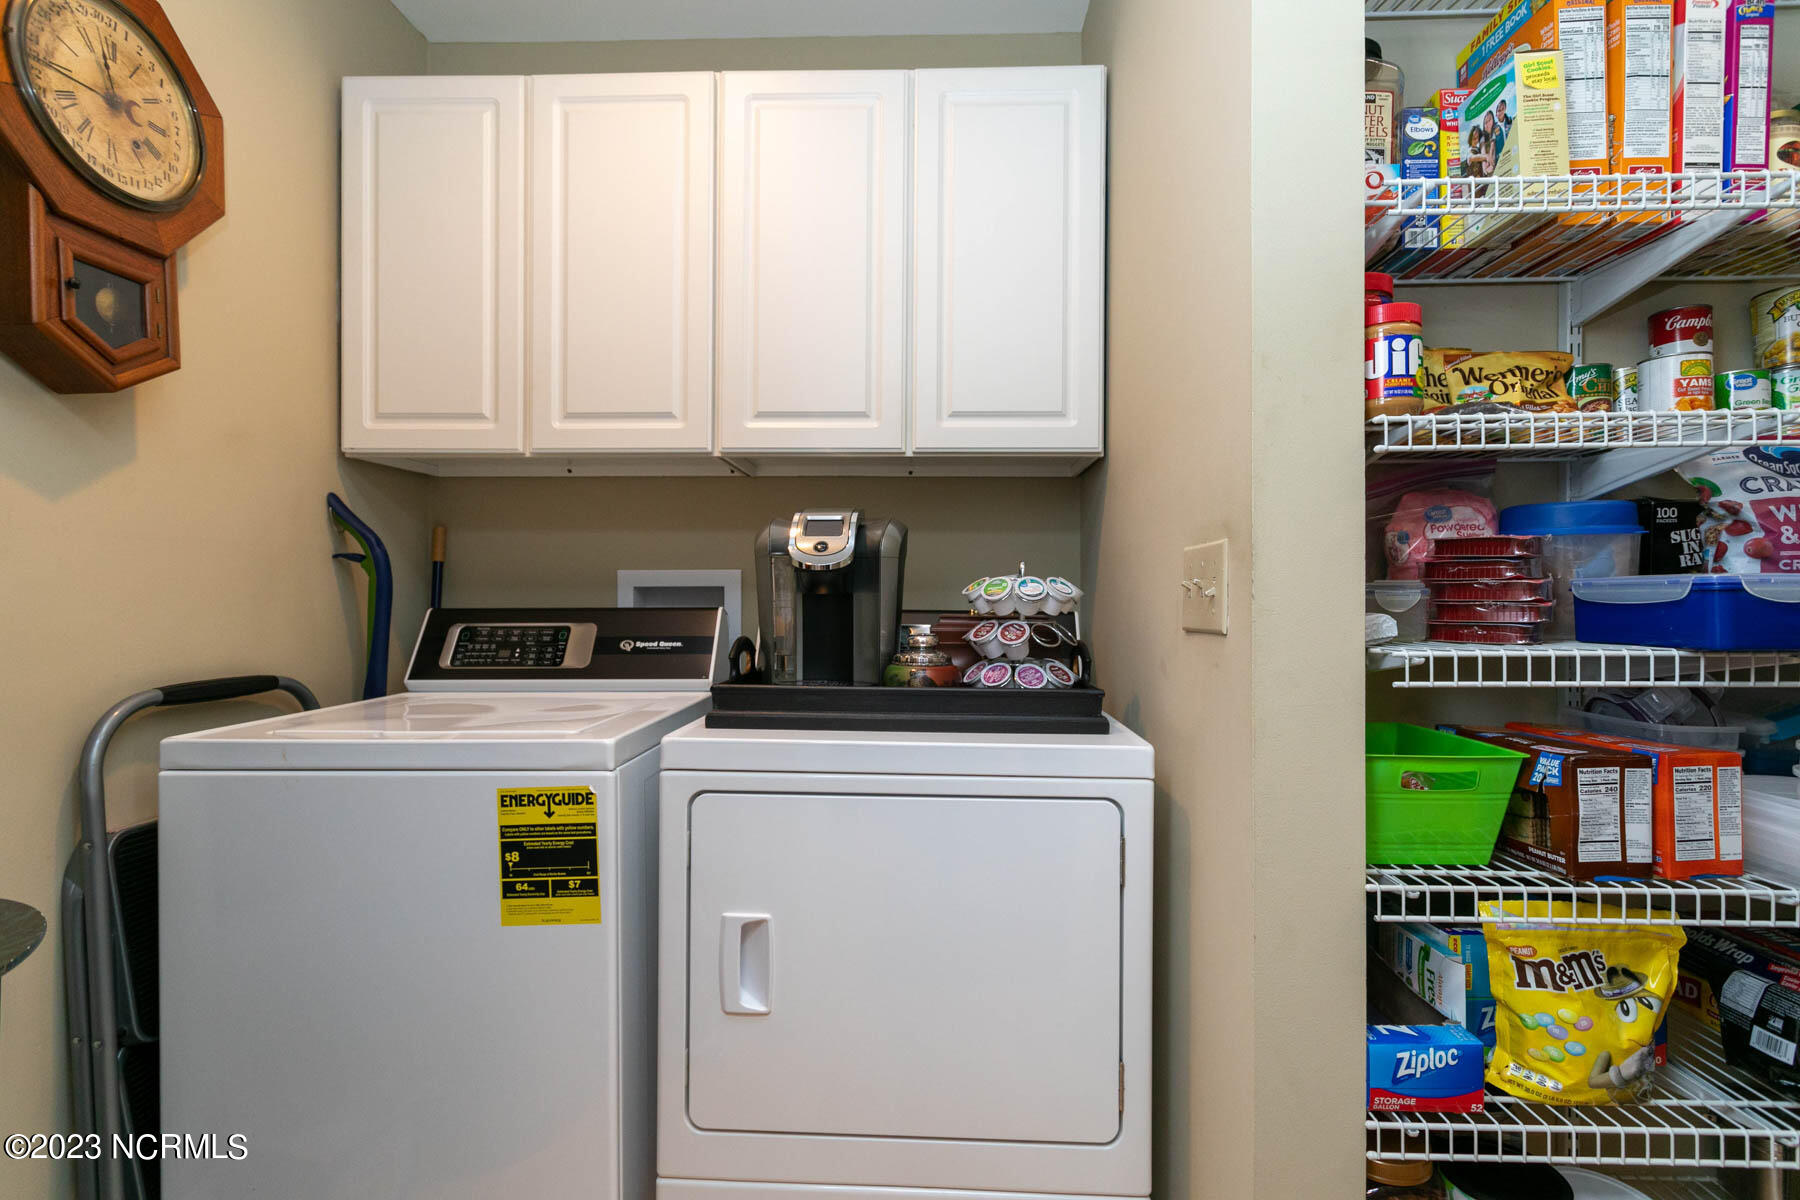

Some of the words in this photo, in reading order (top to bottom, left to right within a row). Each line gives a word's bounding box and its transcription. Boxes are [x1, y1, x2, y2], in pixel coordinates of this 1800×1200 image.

[90, 7, 104, 22] 30
[104, 15, 117, 32] 31
[1485, 27, 1505, 53] FREE
[1504, 3, 1529, 34] BOOK
[1470, 11, 1504, 53] FAMILY
[1525, 71, 1550, 80] proceeds
[1365, 338, 1423, 380] Jif
[1452, 365, 1564, 386] Werer's
[1567, 368, 1598, 386] Amy's
[1680, 379, 1712, 387] YAMS
[1488, 379, 1560, 400] Orinal
[1749, 453, 1784, 472] Ocean
[1656, 507, 1678, 518] 100
[1430, 522, 1485, 534] Powdered
[1671, 527, 1700, 544] SUG
[1679, 553, 1704, 567] RA
[1539, 757, 1560, 768] VALUE
[501, 792, 594, 809] ENERGYGUIDE
[505, 851, 520, 862] $8
[515, 883, 528, 891] 64
[568, 880, 581, 889] $7
[1510, 946, 1533, 955] PEANUT
[1714, 938, 1755, 965] Wrap
[1396, 1048, 1459, 1079] Ziploc
[1373, 1097, 1416, 1105] STORAGE
[1470, 1104, 1483, 1112] 52
